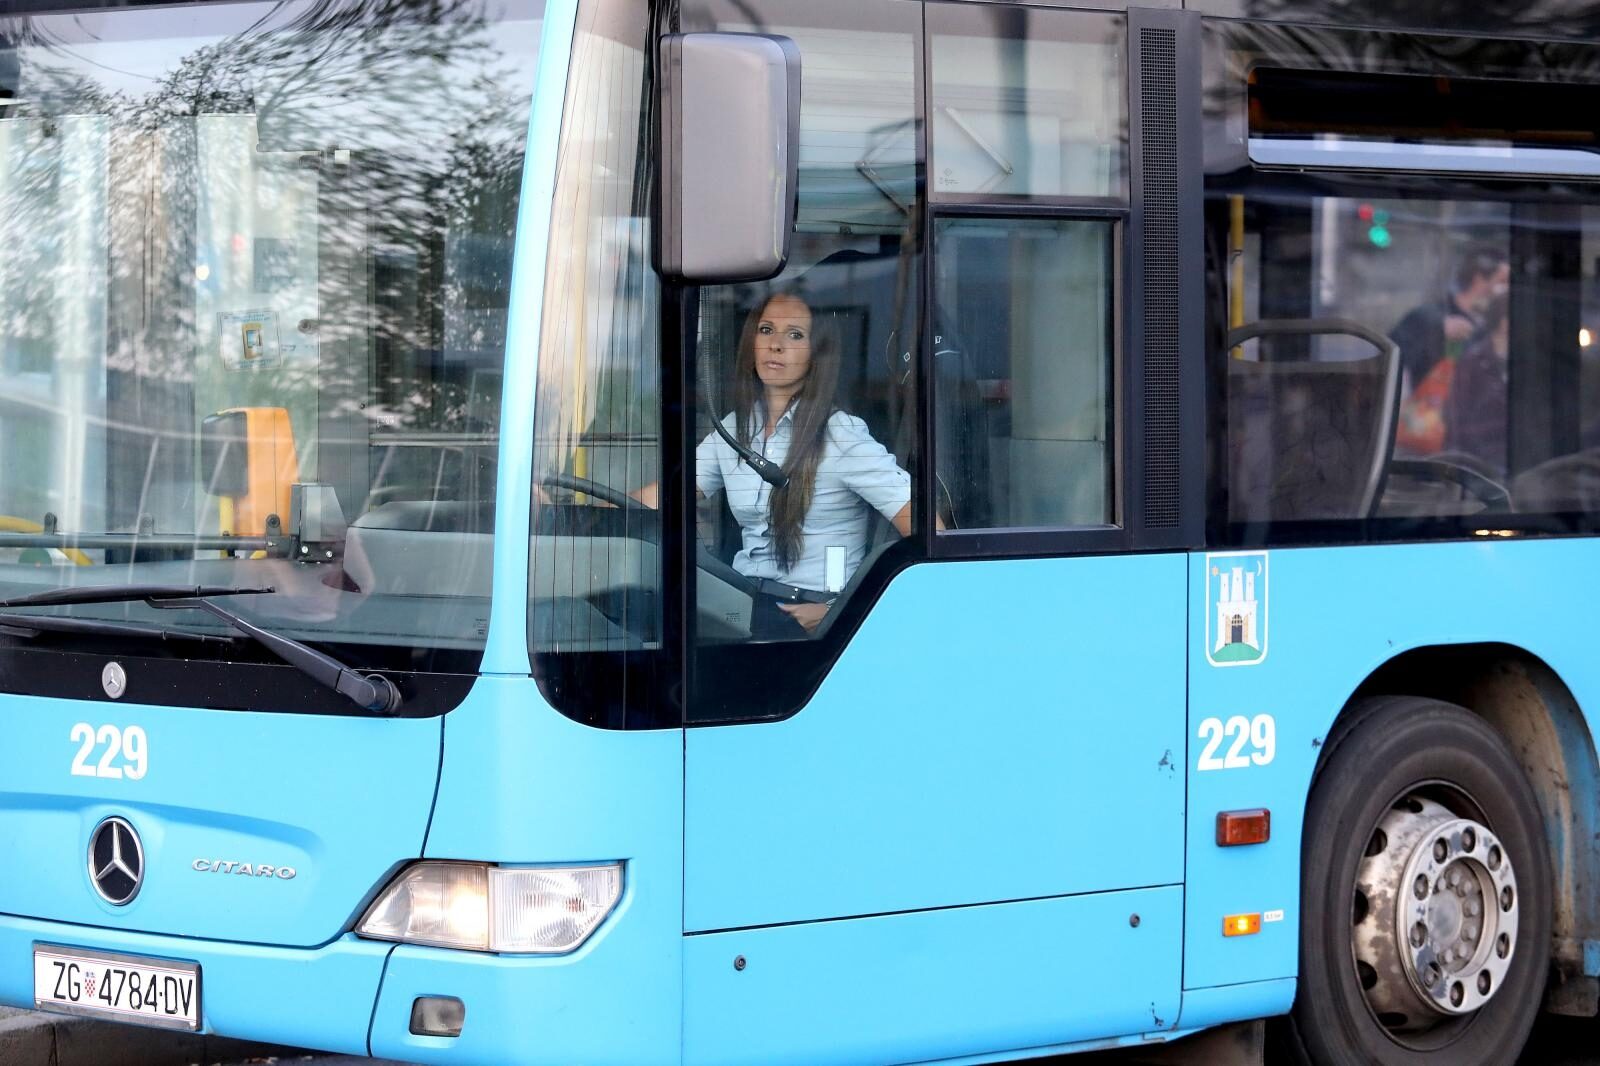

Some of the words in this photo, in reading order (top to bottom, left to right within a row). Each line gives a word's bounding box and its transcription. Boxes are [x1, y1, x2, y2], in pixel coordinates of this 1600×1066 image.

[70, 721, 148, 780] 229
[1197, 713, 1276, 771] 229
[191, 858, 296, 880] CITARO
[53, 961, 81, 1001] ZG
